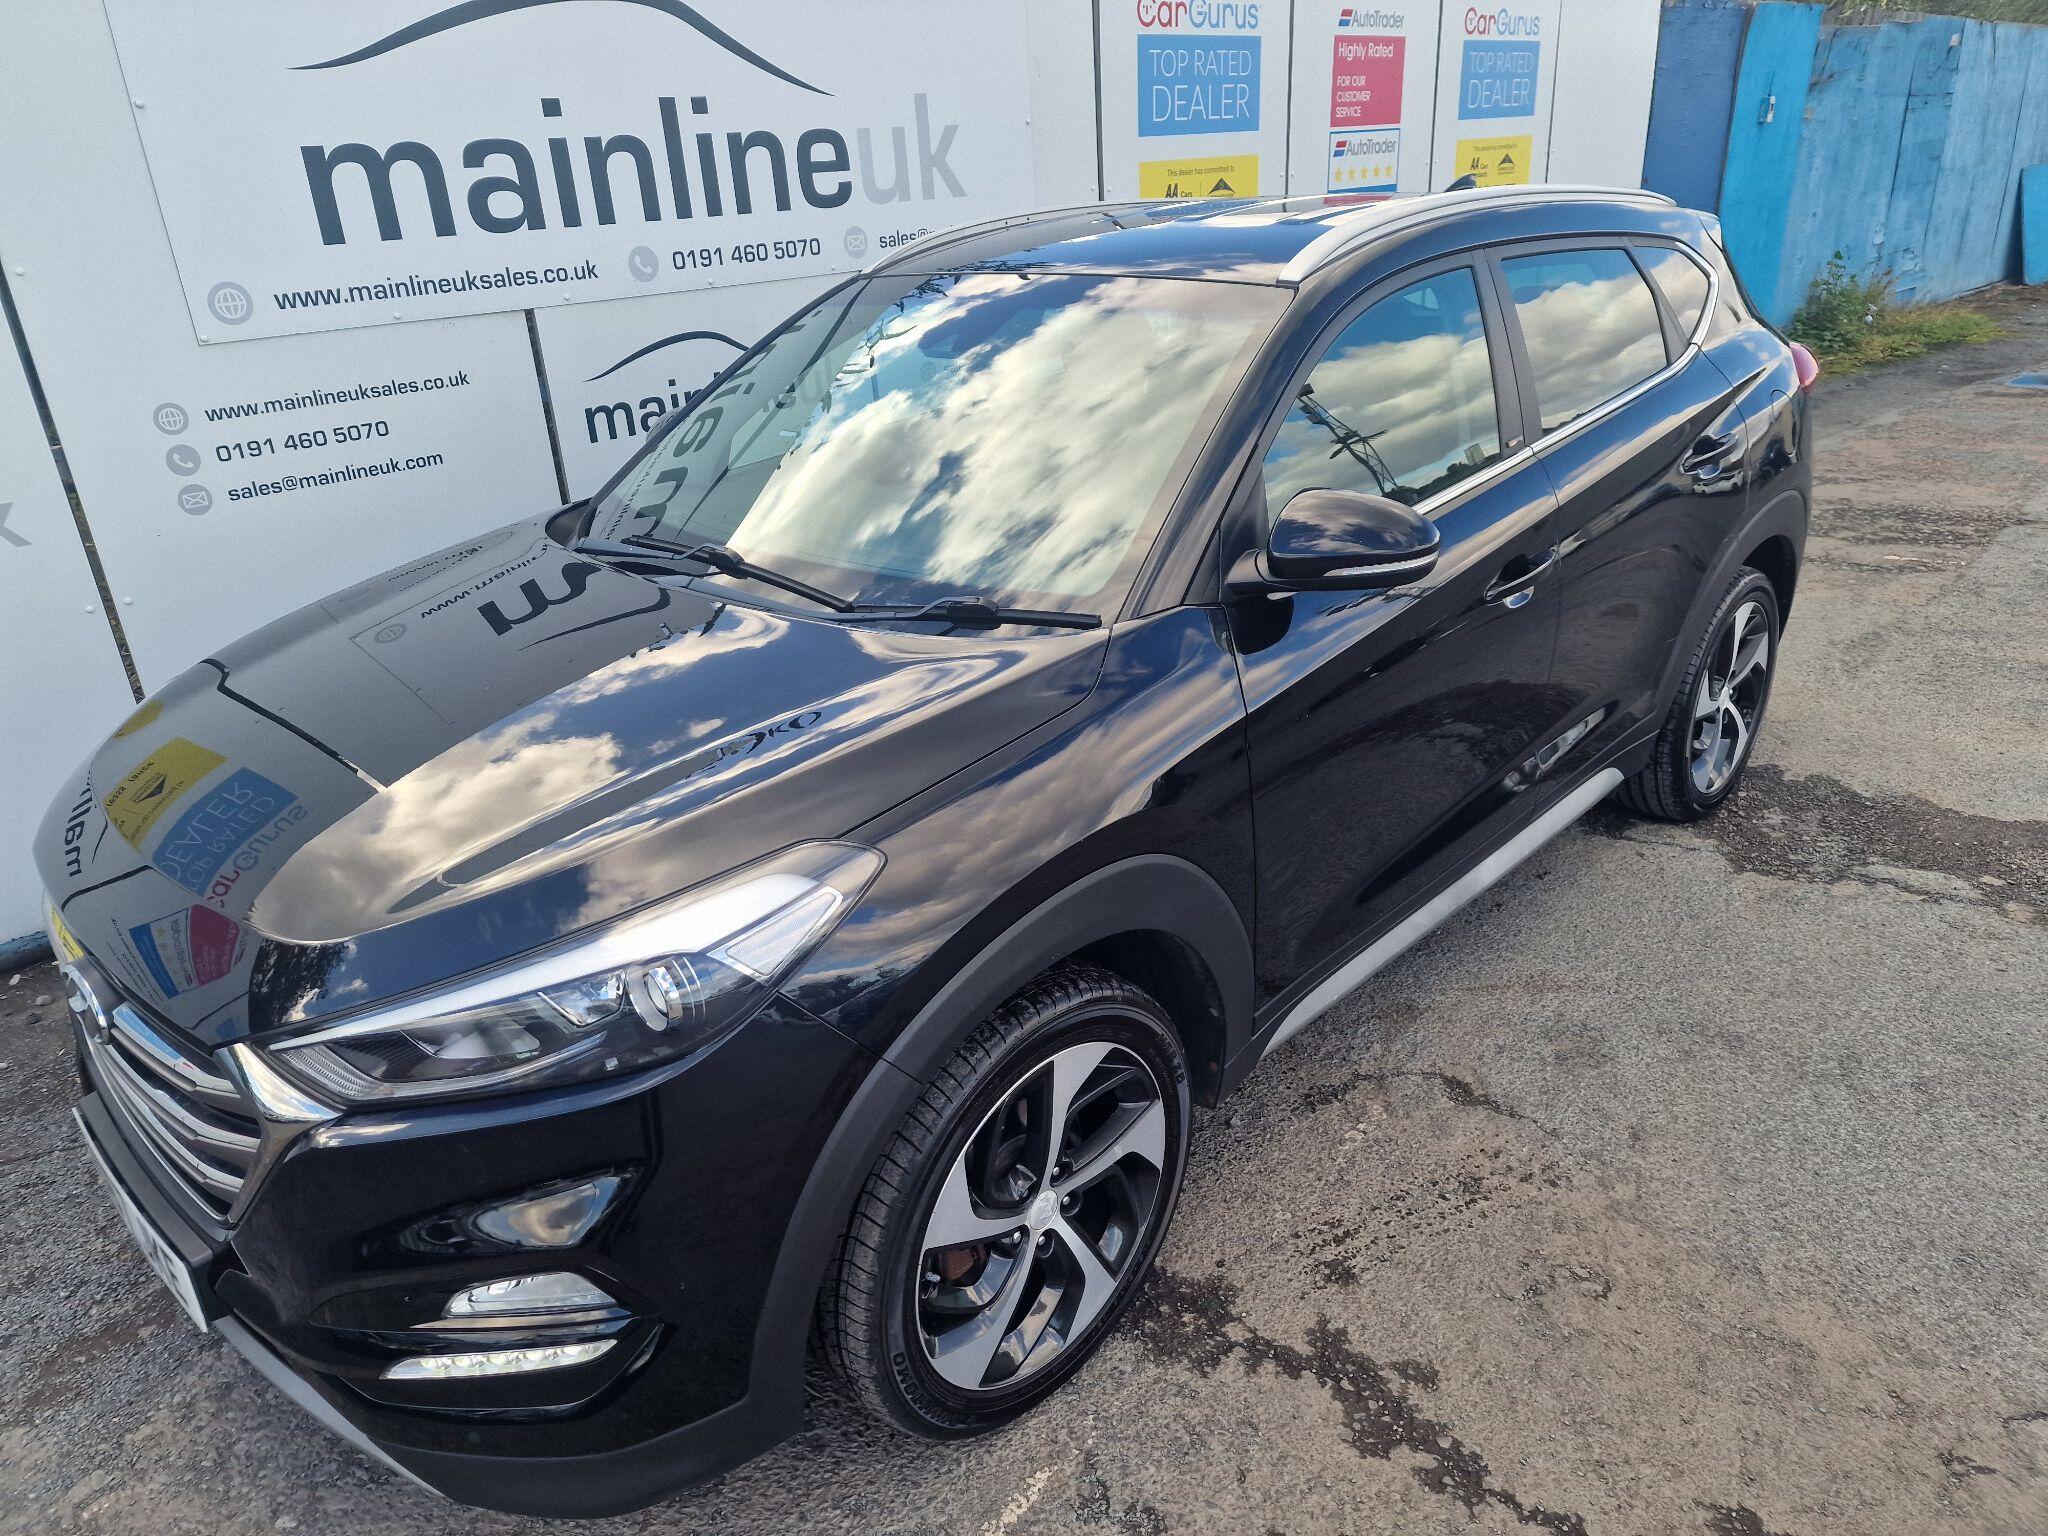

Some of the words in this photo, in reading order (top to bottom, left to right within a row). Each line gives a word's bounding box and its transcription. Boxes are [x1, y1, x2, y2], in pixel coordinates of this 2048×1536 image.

[1136, 0, 1259, 29] CarGurus
[1351, 10, 1404, 28] AutoTrader
[1464, 7, 1541, 36] CarGurus
[1148, 49, 1189, 76] TOP
[1194, 50, 1252, 76] RATED
[1338, 43, 1366, 60] Highly
[1368, 43, 1394, 57] Rated
[1469, 52, 1494, 73] TOP
[1496, 52, 1534, 73] RATED
[1336, 76, 1350, 87] FOR
[1351, 76, 1366, 86] OUR
[1467, 78, 1530, 108] DEALER
[1152, 83, 1250, 122] DEALER
[1336, 91, 1371, 102] CUSTOMER
[1335, 106, 1362, 118] SERVICE
[1346, 138, 1397, 156] AutoTrader
[300, 92, 969, 245] mainlineuk
[1165, 182, 1179, 198] AA
[1180, 190, 1193, 198] Cars
[672, 247, 724, 271] 0191
[731, 243, 769, 264] 460
[773, 237, 821, 260] 5070
[273, 259, 600, 311] www.mainlineuksales.co.uk
[205, 370, 470, 421] www.mainlineuksales.co.uk
[215, 437, 276, 462] 0191
[283, 429, 328, 451] 460
[332, 420, 390, 443] 5070
[227, 453, 444, 502] sales@mainlineuk.com
